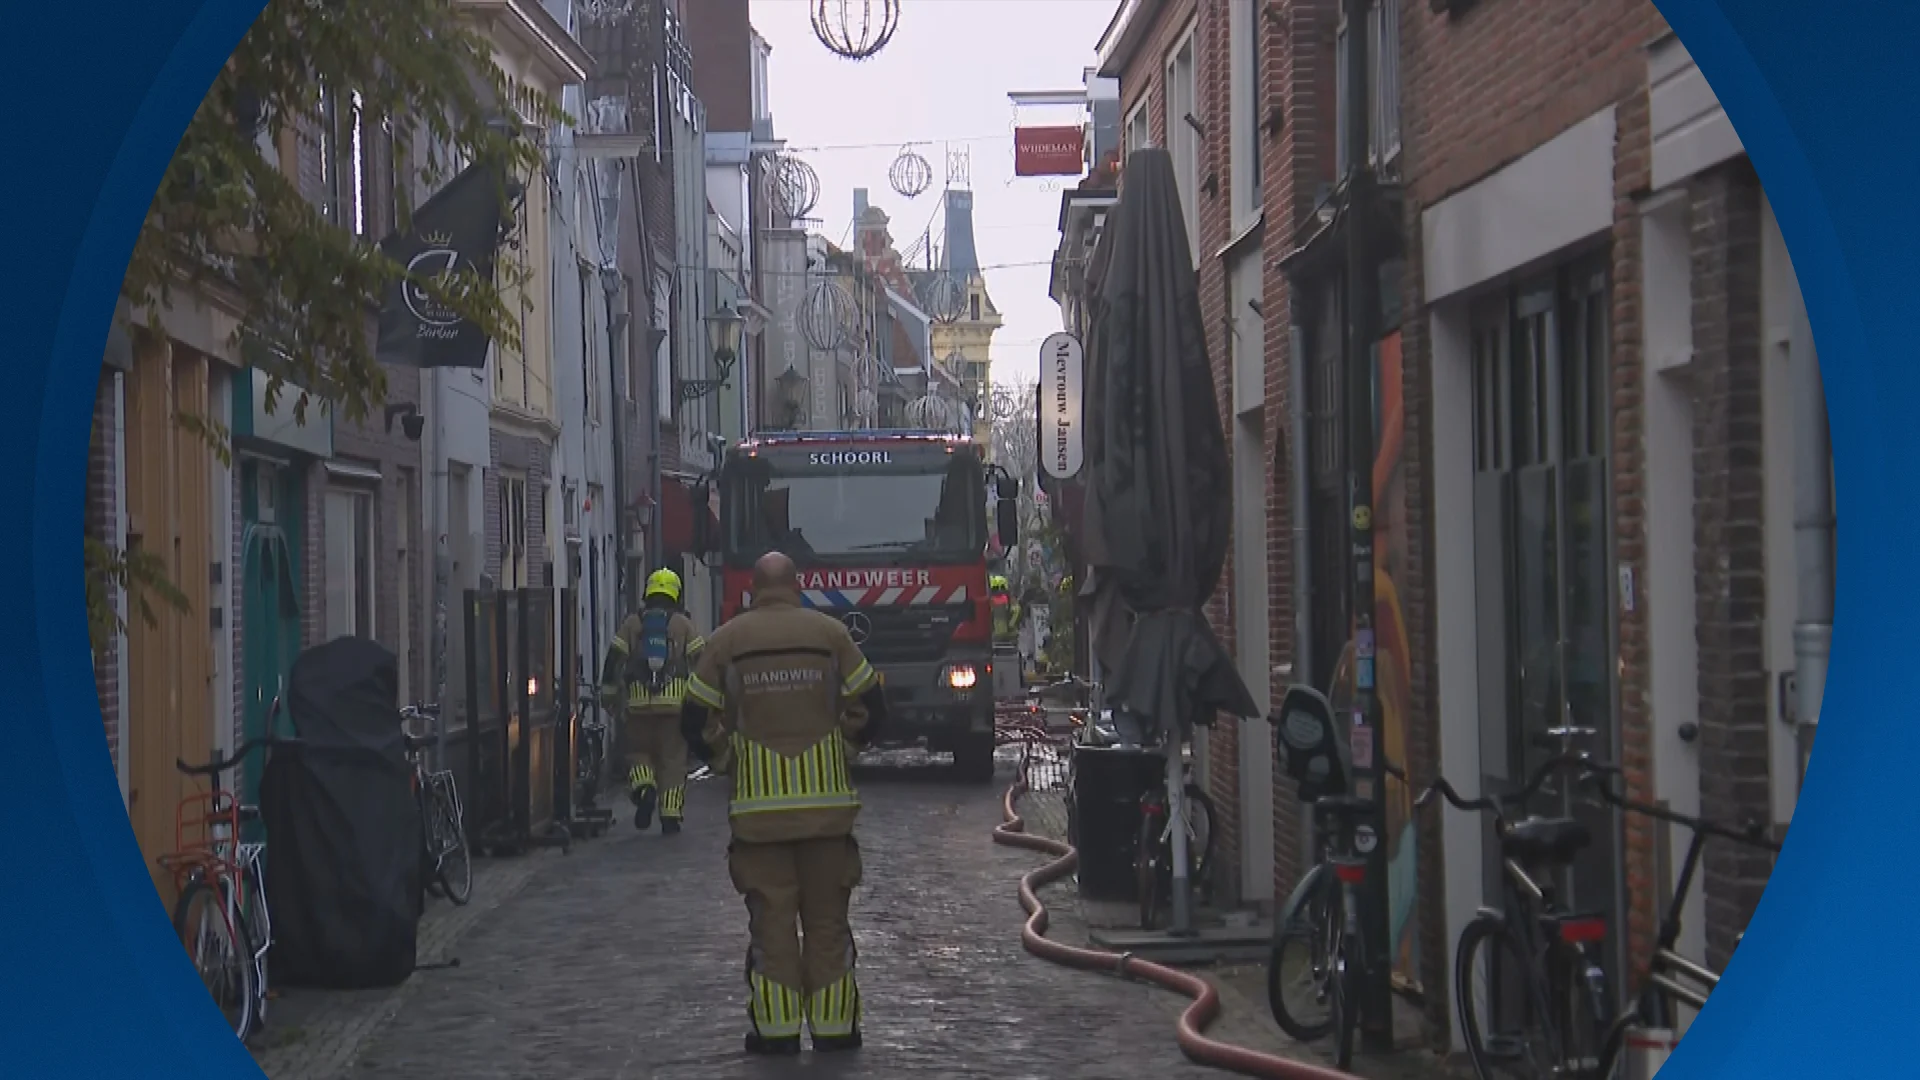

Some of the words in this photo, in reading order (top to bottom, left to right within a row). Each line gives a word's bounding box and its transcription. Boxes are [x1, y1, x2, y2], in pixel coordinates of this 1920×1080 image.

[1056, 341, 1070, 414] Mevrouw
[1057, 417, 1071, 472] Jansen
[809, 451, 892, 465] SCHOORL
[796, 569, 931, 589] RANDWEER
[743, 667, 823, 685] BRANDWEER
